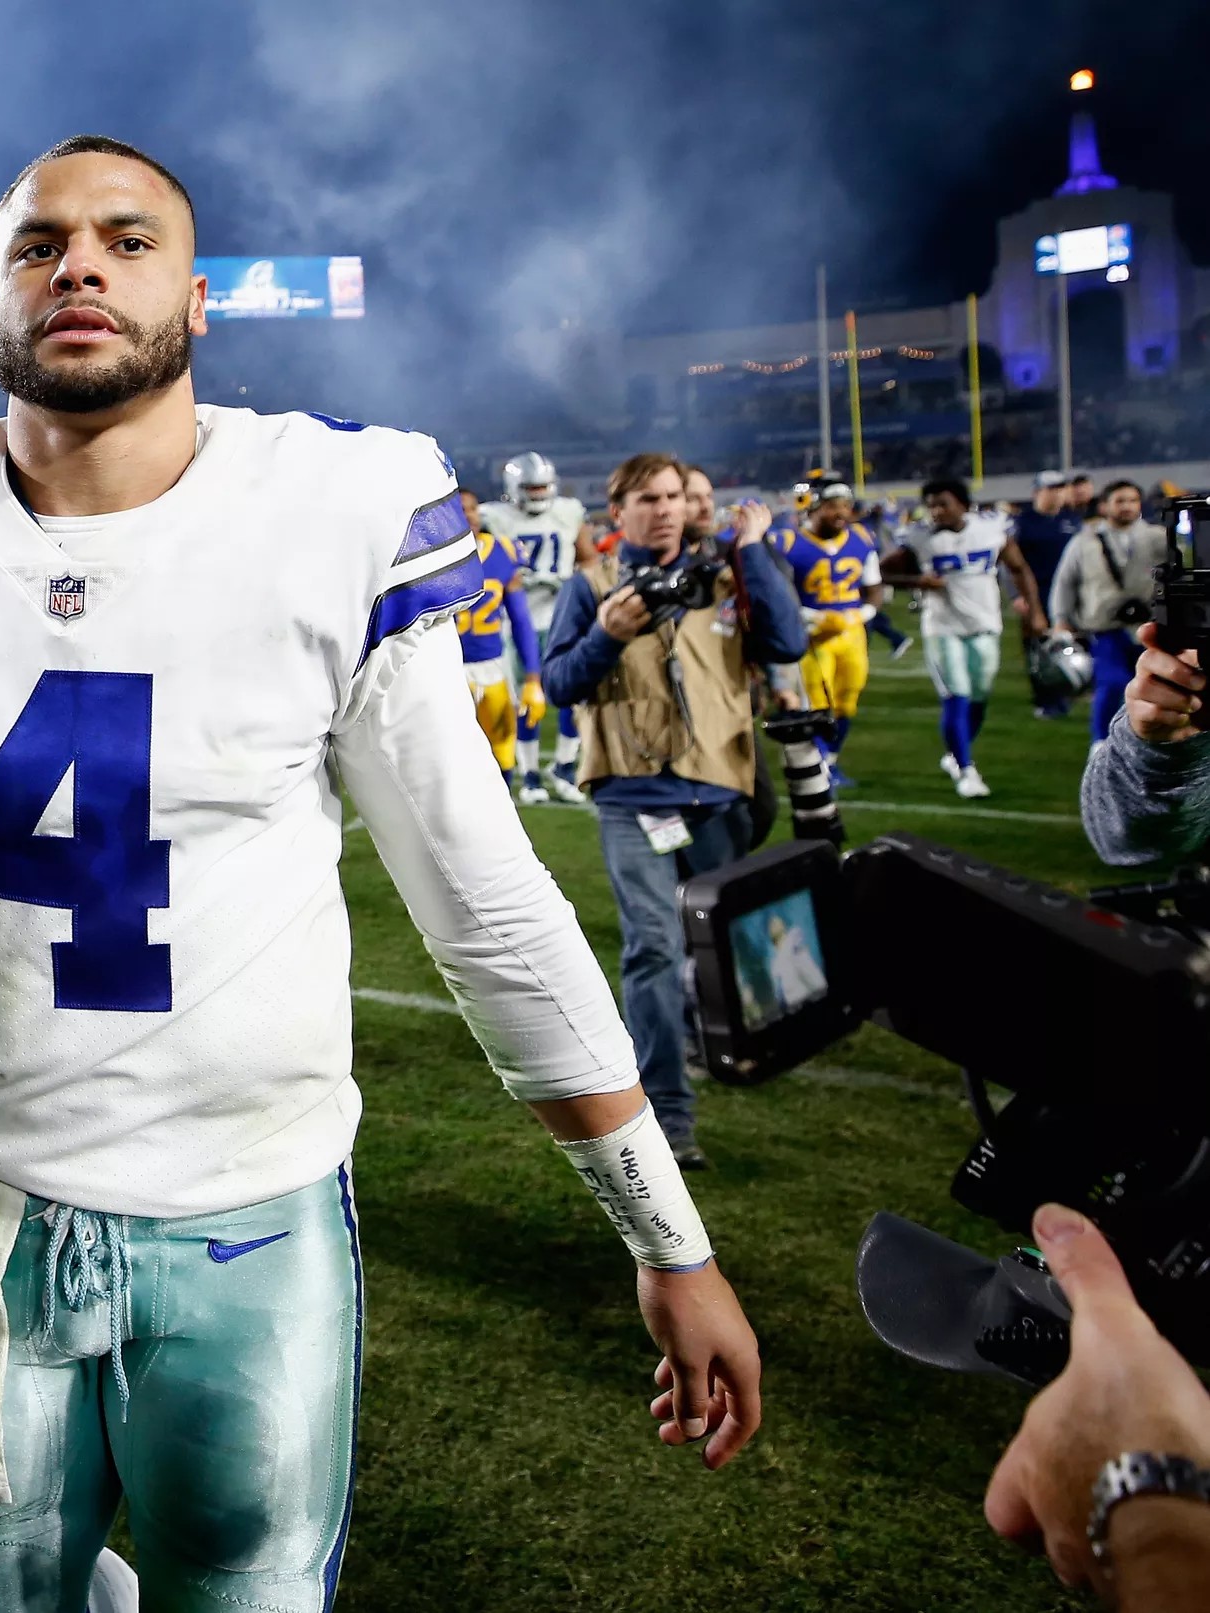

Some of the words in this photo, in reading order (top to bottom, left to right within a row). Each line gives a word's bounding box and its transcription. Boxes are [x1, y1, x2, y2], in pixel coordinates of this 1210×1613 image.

[517, 533, 559, 572] 71
[804, 557, 863, 604] 42
[52, 593, 82, 613] NFL
